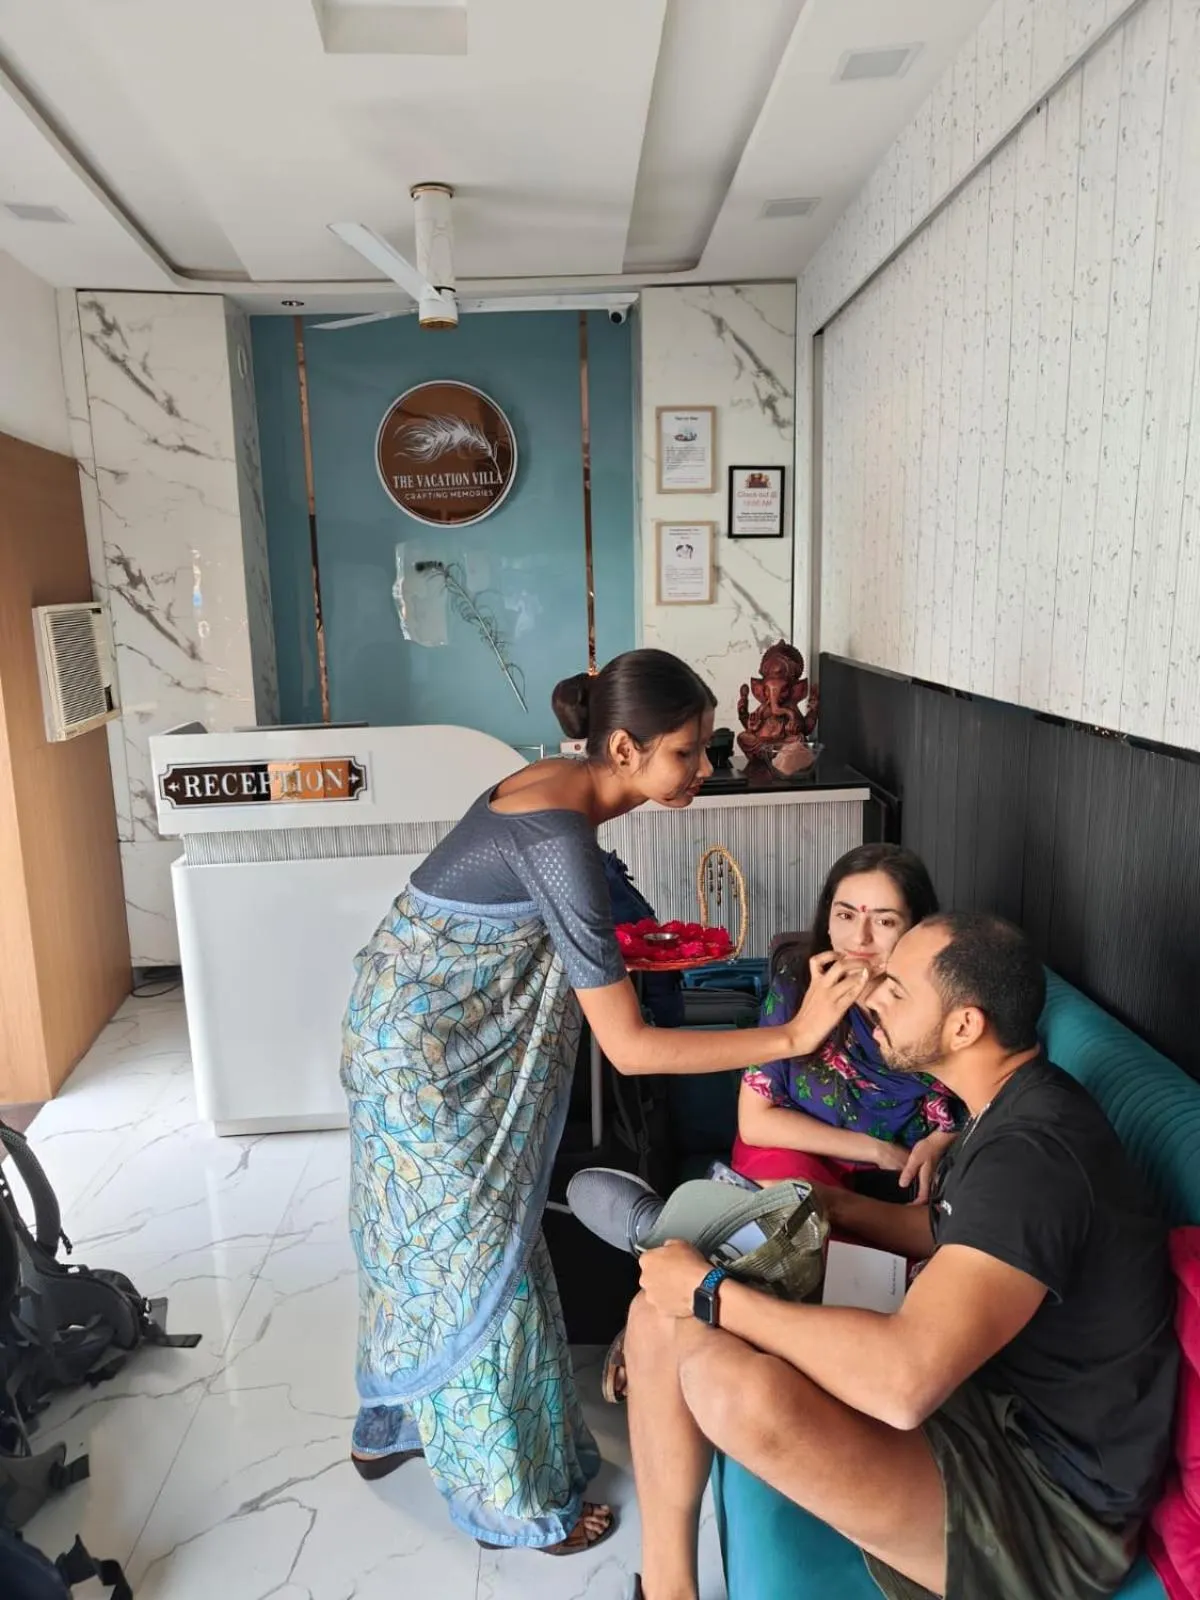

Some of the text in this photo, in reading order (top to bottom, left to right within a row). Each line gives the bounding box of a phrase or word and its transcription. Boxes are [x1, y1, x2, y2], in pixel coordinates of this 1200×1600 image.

[393, 471, 504, 489] THE VACATION VILLA
[405, 489, 494, 500] CRAFTING MEMORIES
[183, 767, 343, 798] RECEPTION
